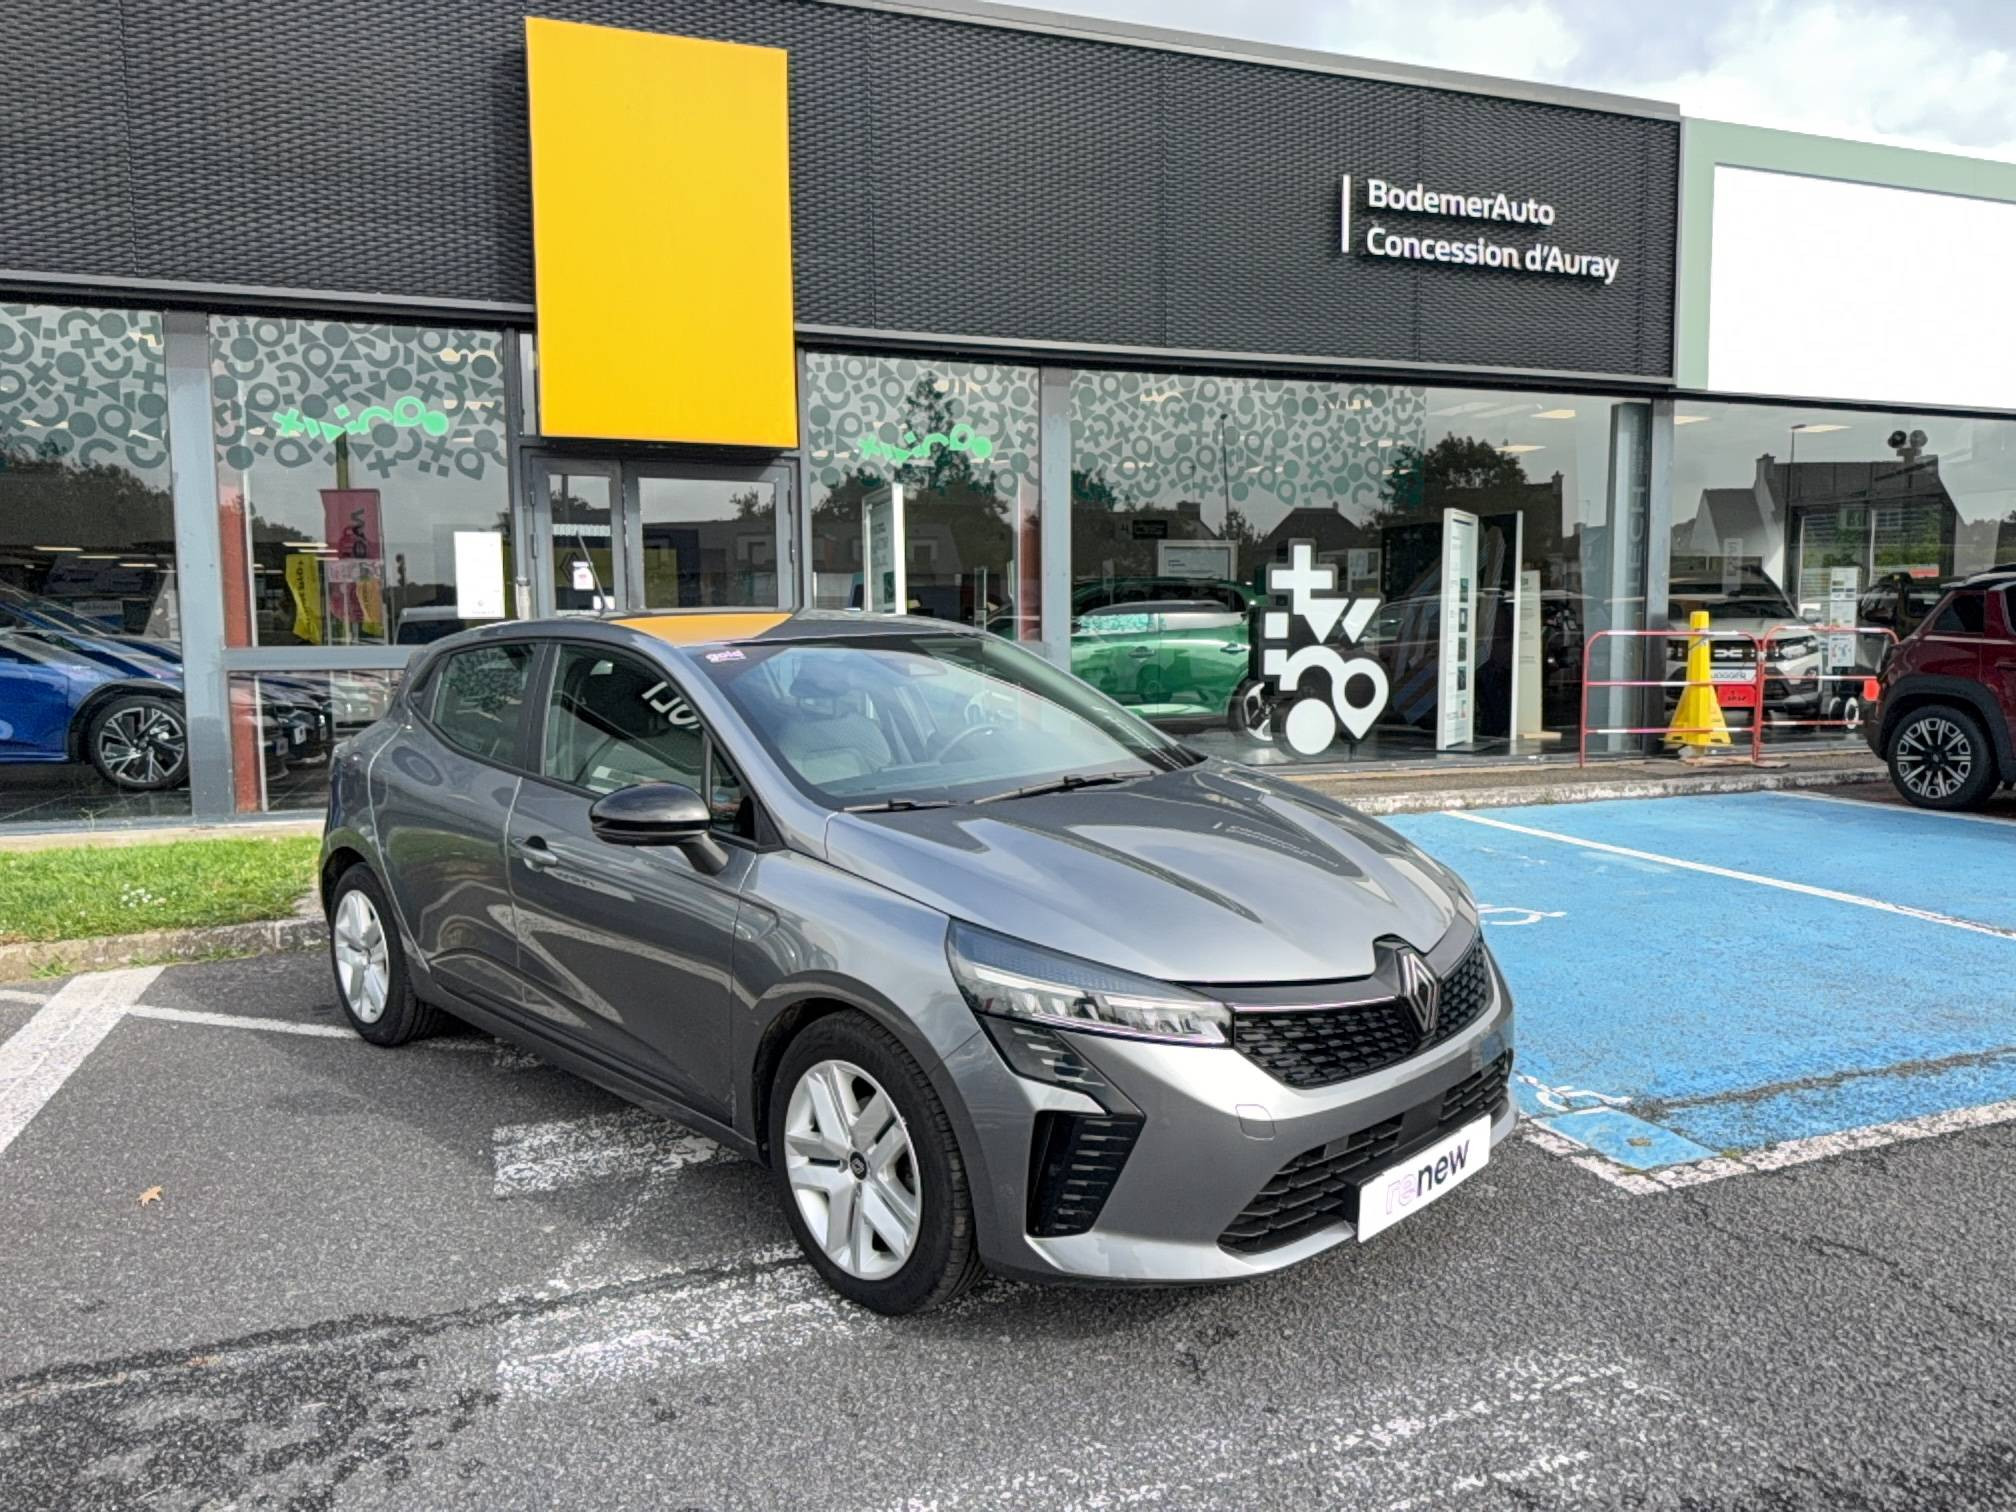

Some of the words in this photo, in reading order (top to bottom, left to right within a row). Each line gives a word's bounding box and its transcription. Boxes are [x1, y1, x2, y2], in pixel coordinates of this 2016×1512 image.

[1367, 178, 1556, 226] BodemerAuto
[1366, 227, 1521, 270] Concession
[1524, 243, 1620, 285] d'Auray
[1386, 1139, 1470, 1216] renew
